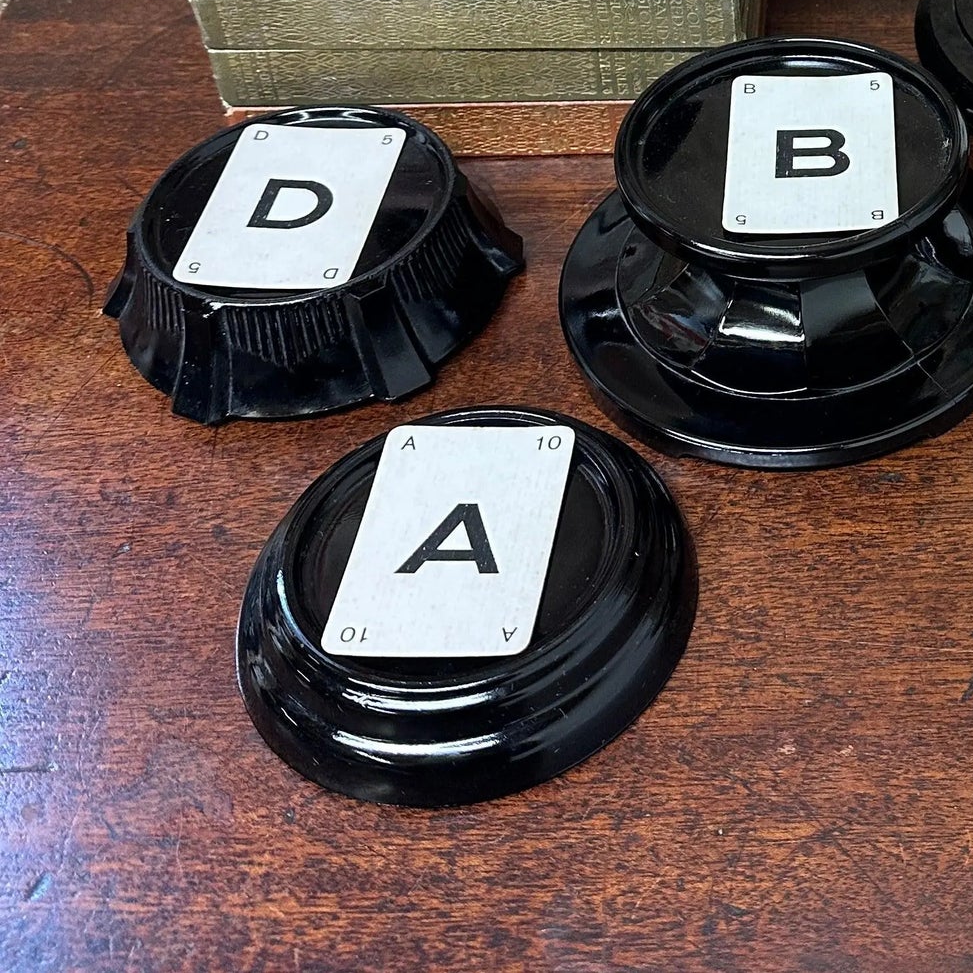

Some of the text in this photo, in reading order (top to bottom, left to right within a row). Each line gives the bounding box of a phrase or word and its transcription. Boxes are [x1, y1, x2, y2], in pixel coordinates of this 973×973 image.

[687, 12, 702, 45] OLD
[614, 52, 629, 95] CHARLES
[743, 83, 756, 94] B
[869, 79, 881, 91] 5
[253, 130, 269, 141] D
[382, 134, 393, 145] 5
[774, 128, 851, 179] B
[245, 178, 334, 230] D
[735, 214, 747, 226] 5
[870, 209, 884, 221] B
[188, 261, 201, 274] 5
[322, 267, 339, 280] D
[400, 435, 416, 451] A
[537, 435, 562, 451] 10
[393, 503, 500, 575] A
[340, 626, 367, 643] 10
[502, 626, 518, 643] A
